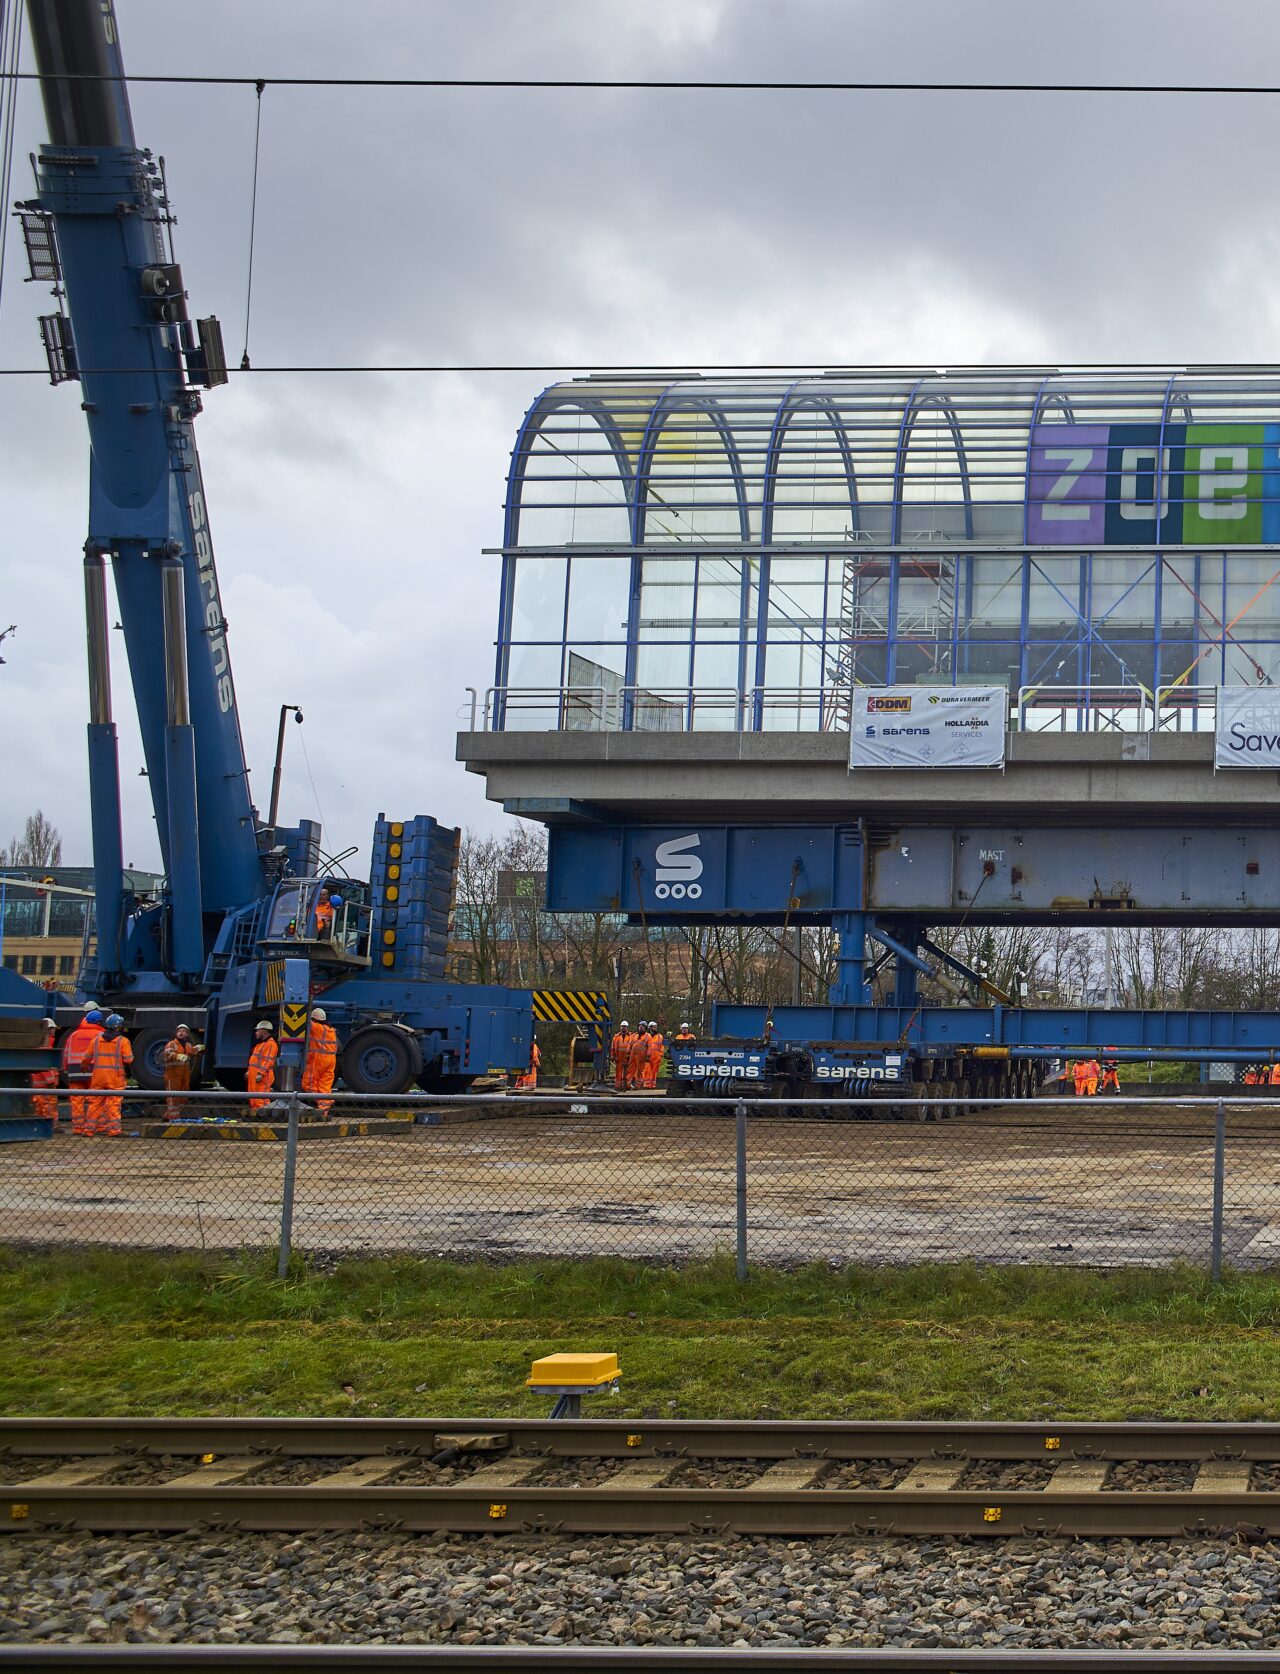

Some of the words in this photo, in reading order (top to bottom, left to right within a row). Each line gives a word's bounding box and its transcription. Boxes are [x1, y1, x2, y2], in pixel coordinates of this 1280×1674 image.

[189, 491, 232, 713] sarens
[875, 699, 908, 709] DDM
[882, 727, 931, 736] sarens
[979, 849, 1005, 861] MAST
[678, 1064, 760, 1077] sarens
[816, 1066, 899, 1079] sarens
